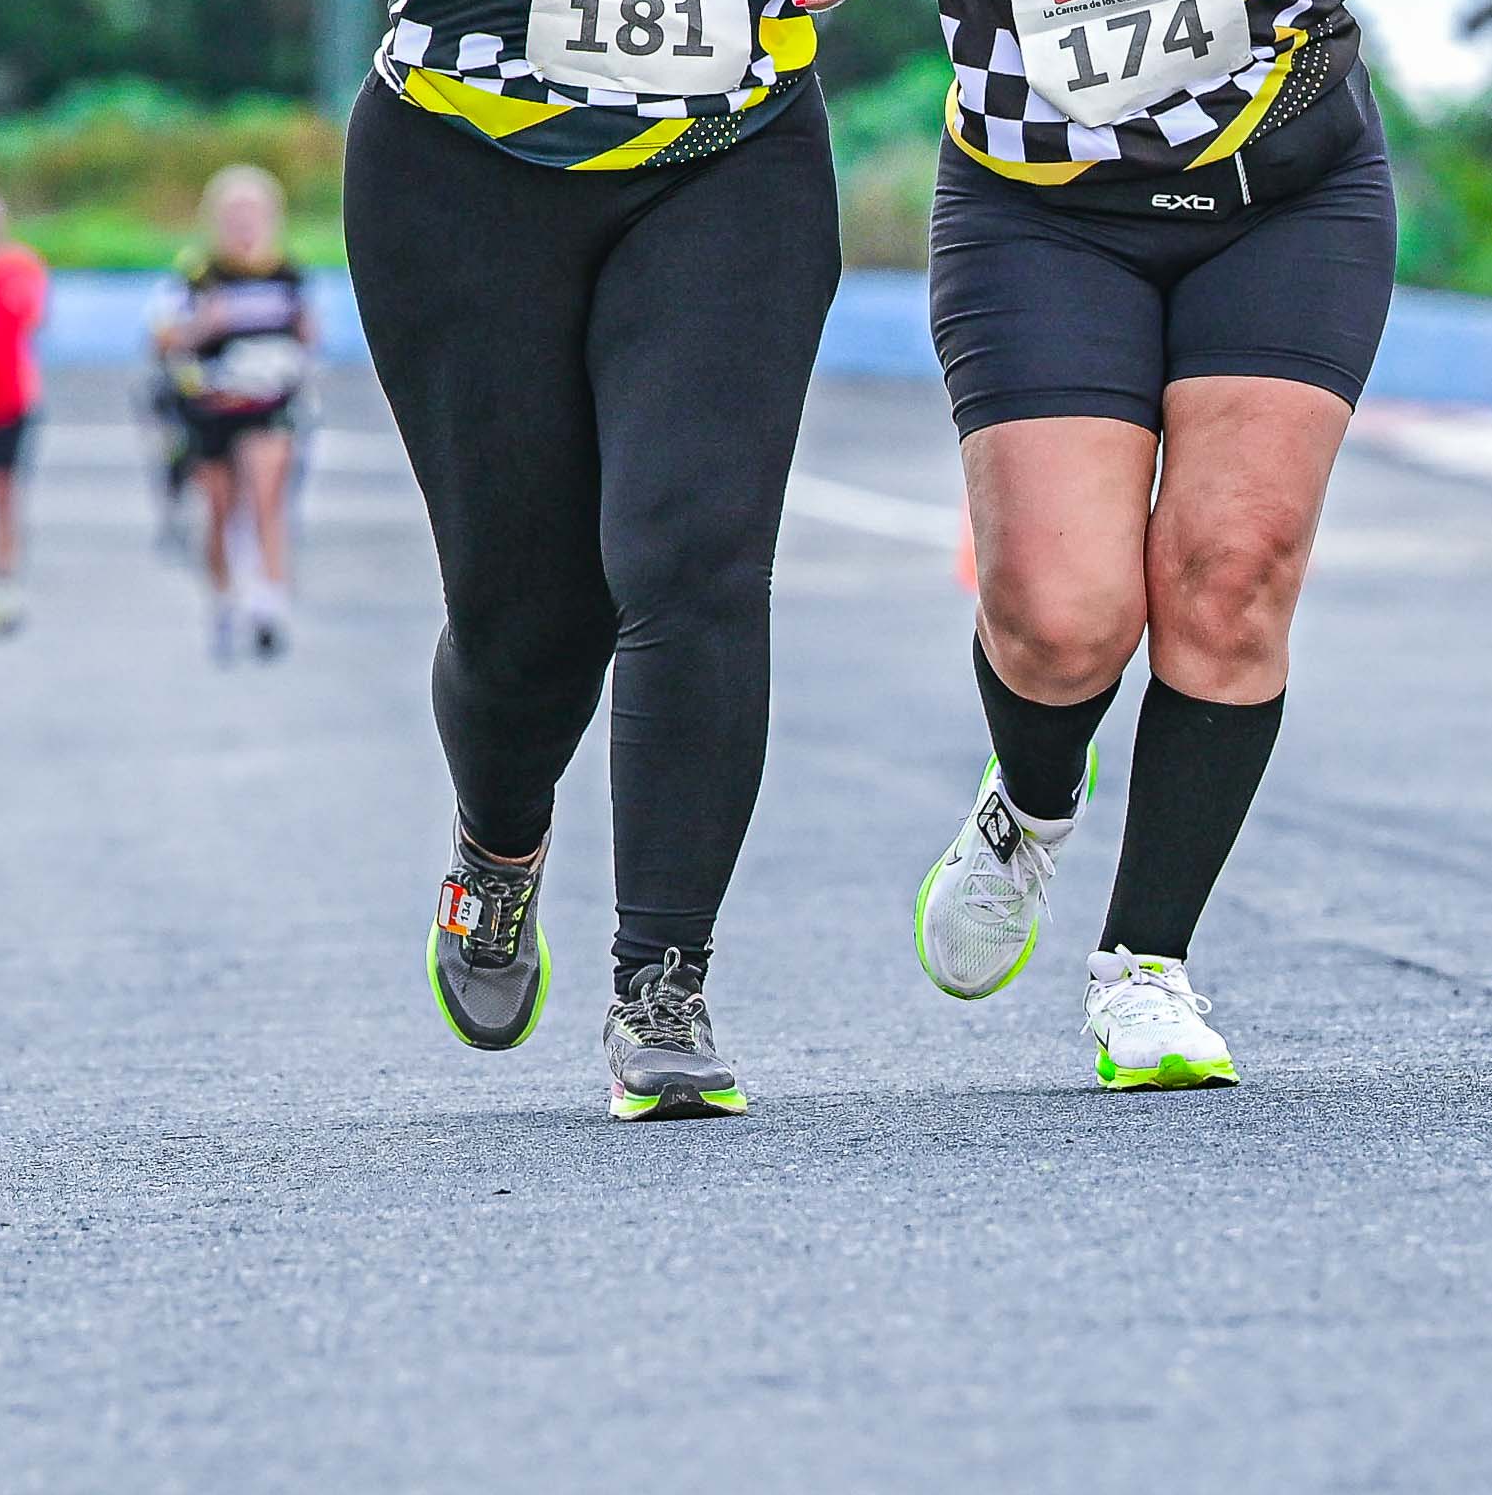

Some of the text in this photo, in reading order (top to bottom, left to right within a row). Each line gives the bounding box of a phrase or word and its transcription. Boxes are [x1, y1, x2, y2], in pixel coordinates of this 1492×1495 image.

[1043, 9, 1055, 19] La
[1055, 3, 1089, 16] Carrera
[1089, 0, 1101, 9] de
[460, 901, 472, 921] 134
